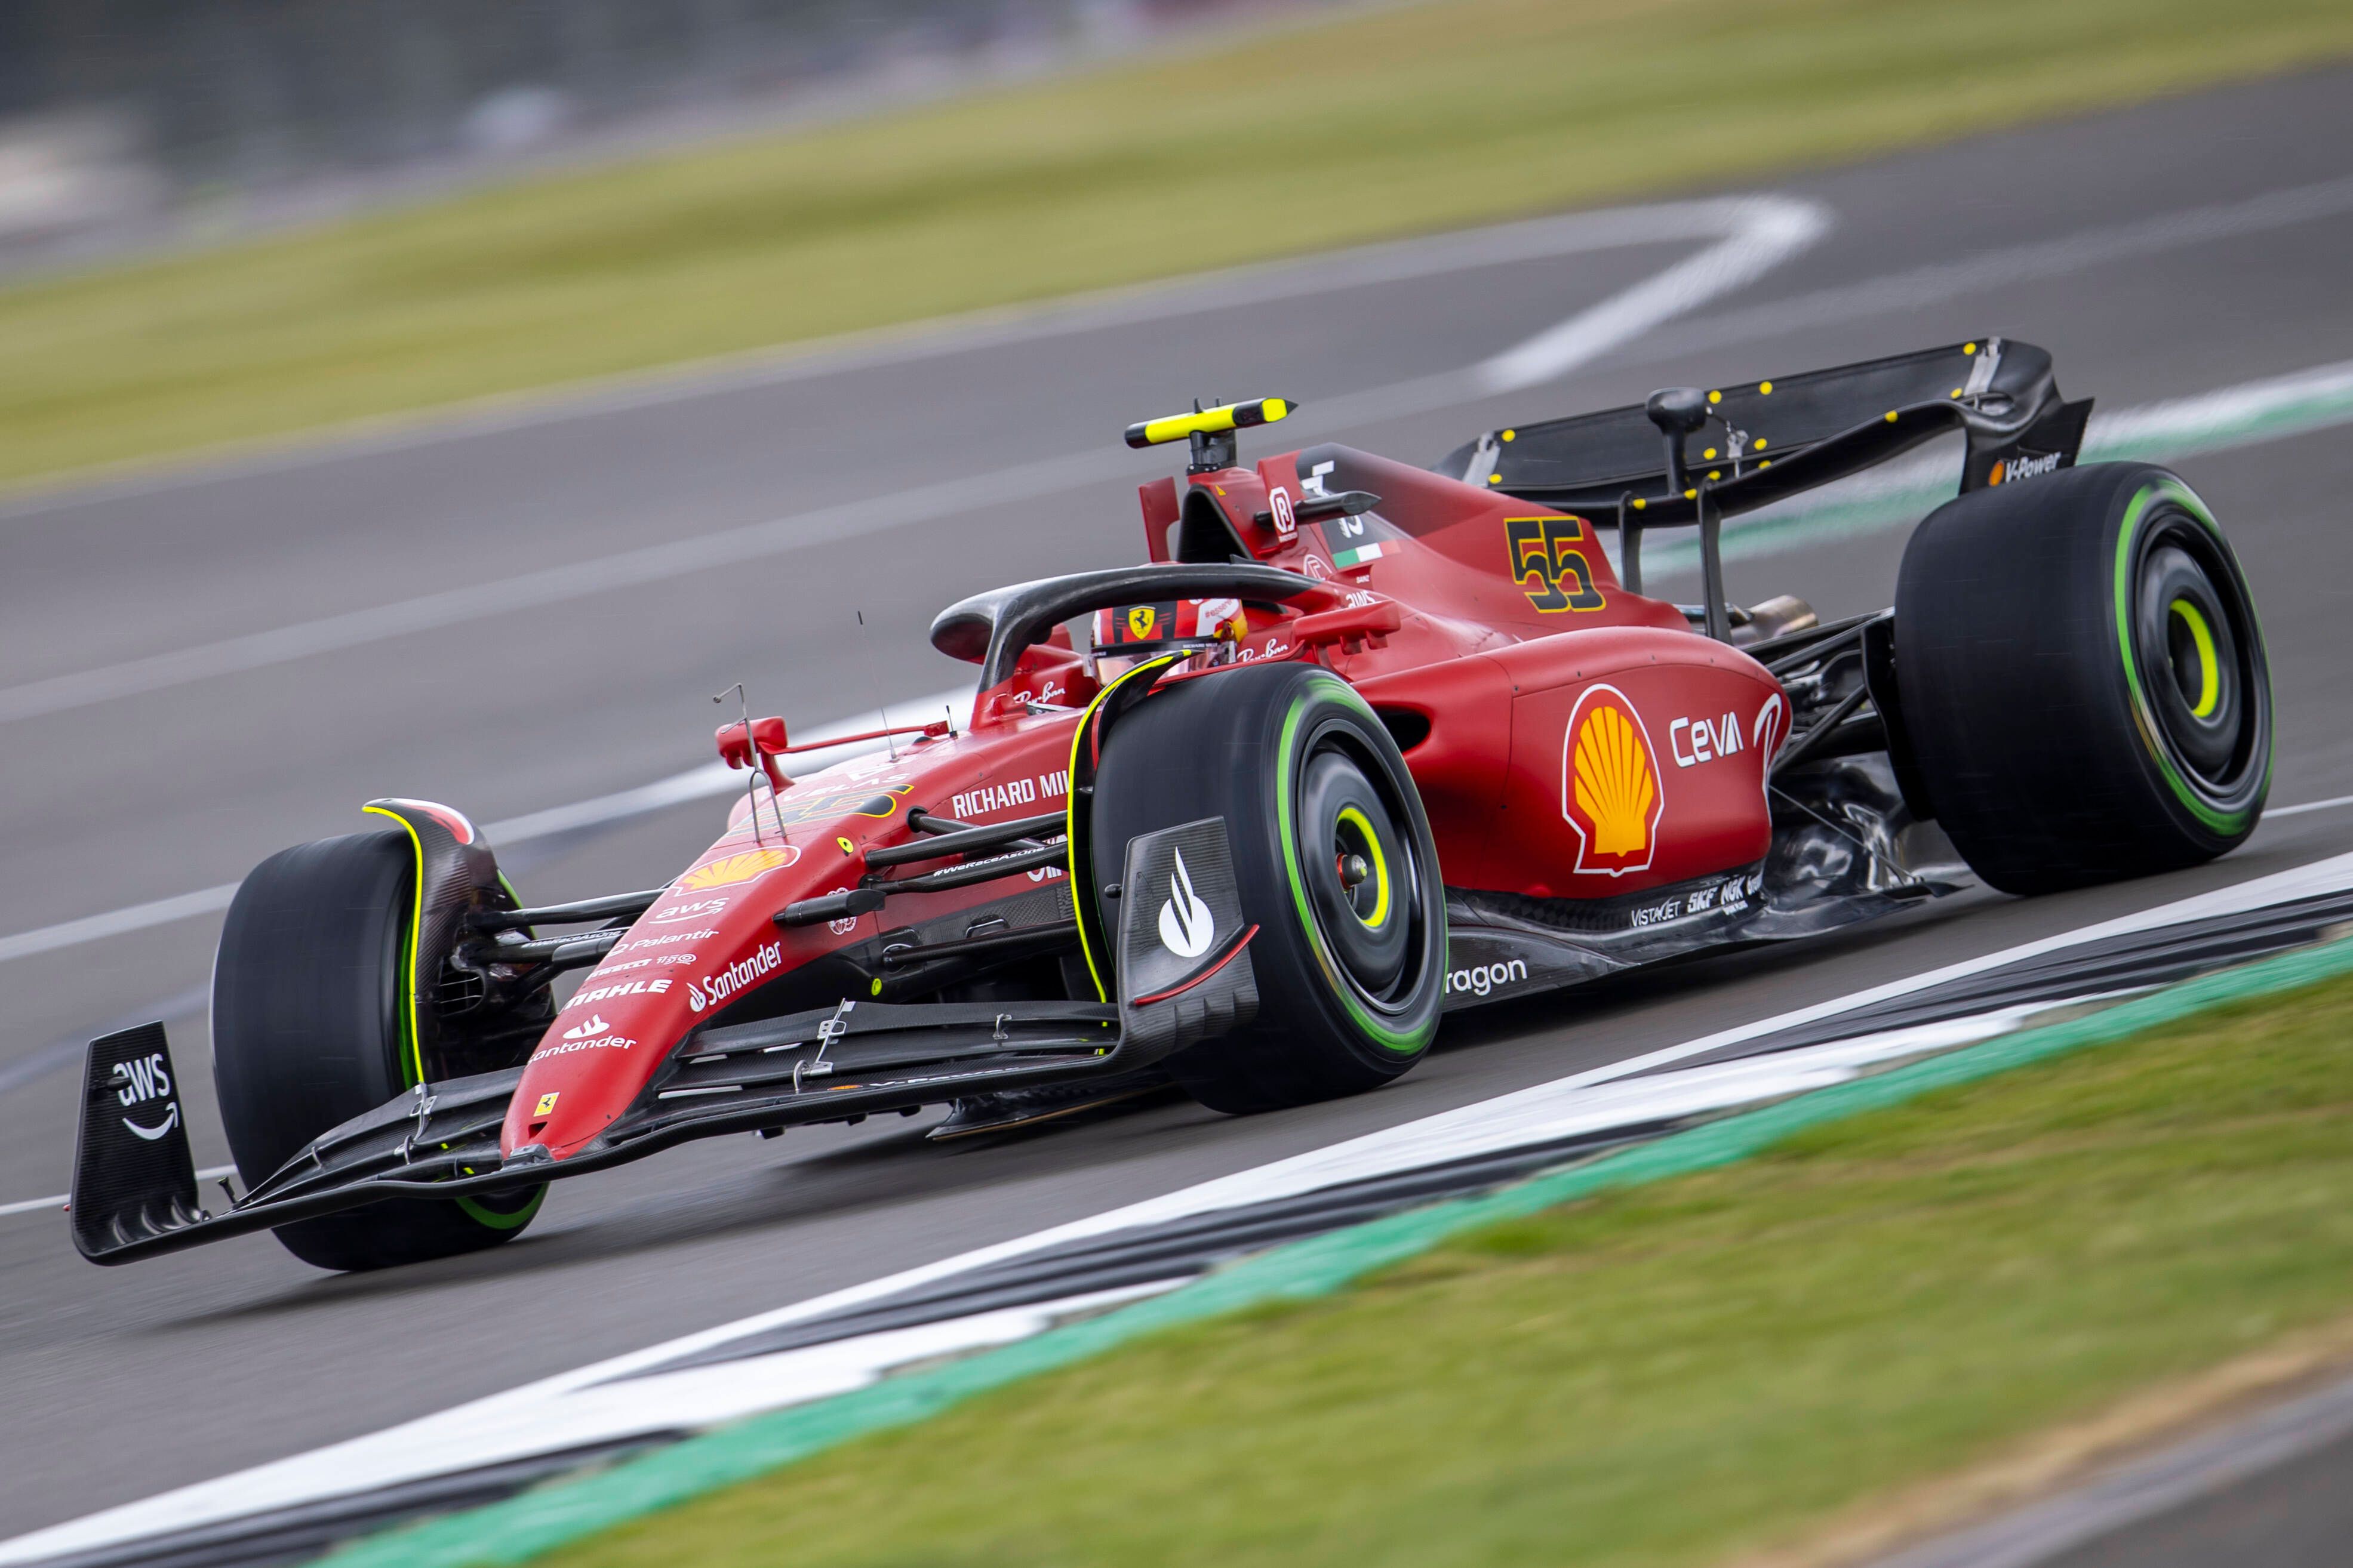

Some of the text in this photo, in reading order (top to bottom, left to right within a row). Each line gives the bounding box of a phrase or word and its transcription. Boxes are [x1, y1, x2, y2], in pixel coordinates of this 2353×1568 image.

[2006, 451, 2062, 484] V-Power
[1503, 516, 1607, 614] 55
[952, 770, 1069, 819] RICHARD MIL
[933, 846, 1045, 877] #WeRaceAsOne
[656, 897, 730, 919] aws
[1687, 886, 1719, 913] SKF
[629, 928, 719, 951] Palantir
[702, 941, 782, 1006] Santander
[1445, 959, 1528, 996] ragon
[559, 979, 673, 1013] MAHLE
[112, 1053, 171, 1107] aws
